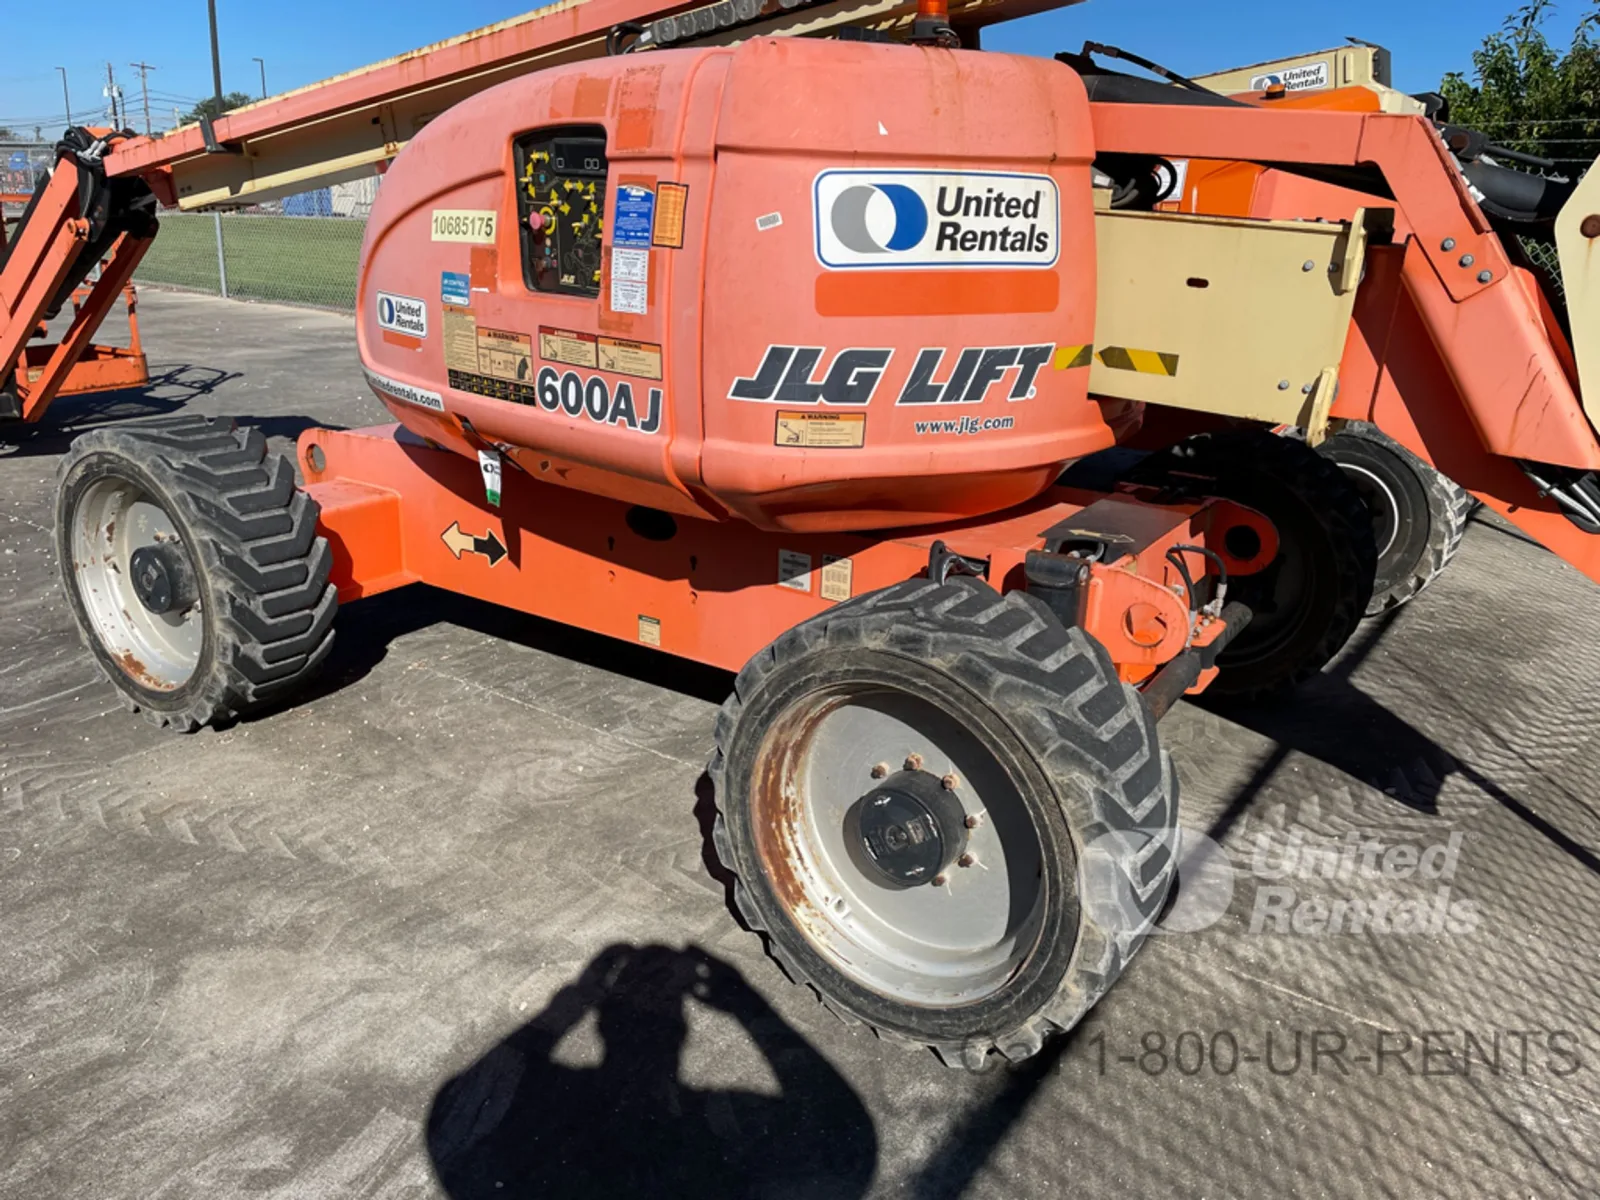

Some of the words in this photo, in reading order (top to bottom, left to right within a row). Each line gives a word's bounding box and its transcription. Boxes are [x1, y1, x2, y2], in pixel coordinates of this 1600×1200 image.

[1283, 65, 1321, 81] United
[1285, 76, 1324, 90] Rentals
[936, 186, 1041, 219] United
[433, 215, 494, 237] 10685175
[935, 221, 1050, 253] Rentals
[395, 301, 422, 317] United
[395, 315, 424, 332] Rentals
[727, 344, 895, 405] JLG
[895, 342, 1056, 405] LIFT
[537, 366, 662, 434] 600AJ
[915, 416, 1015, 435] www.jlg.com
